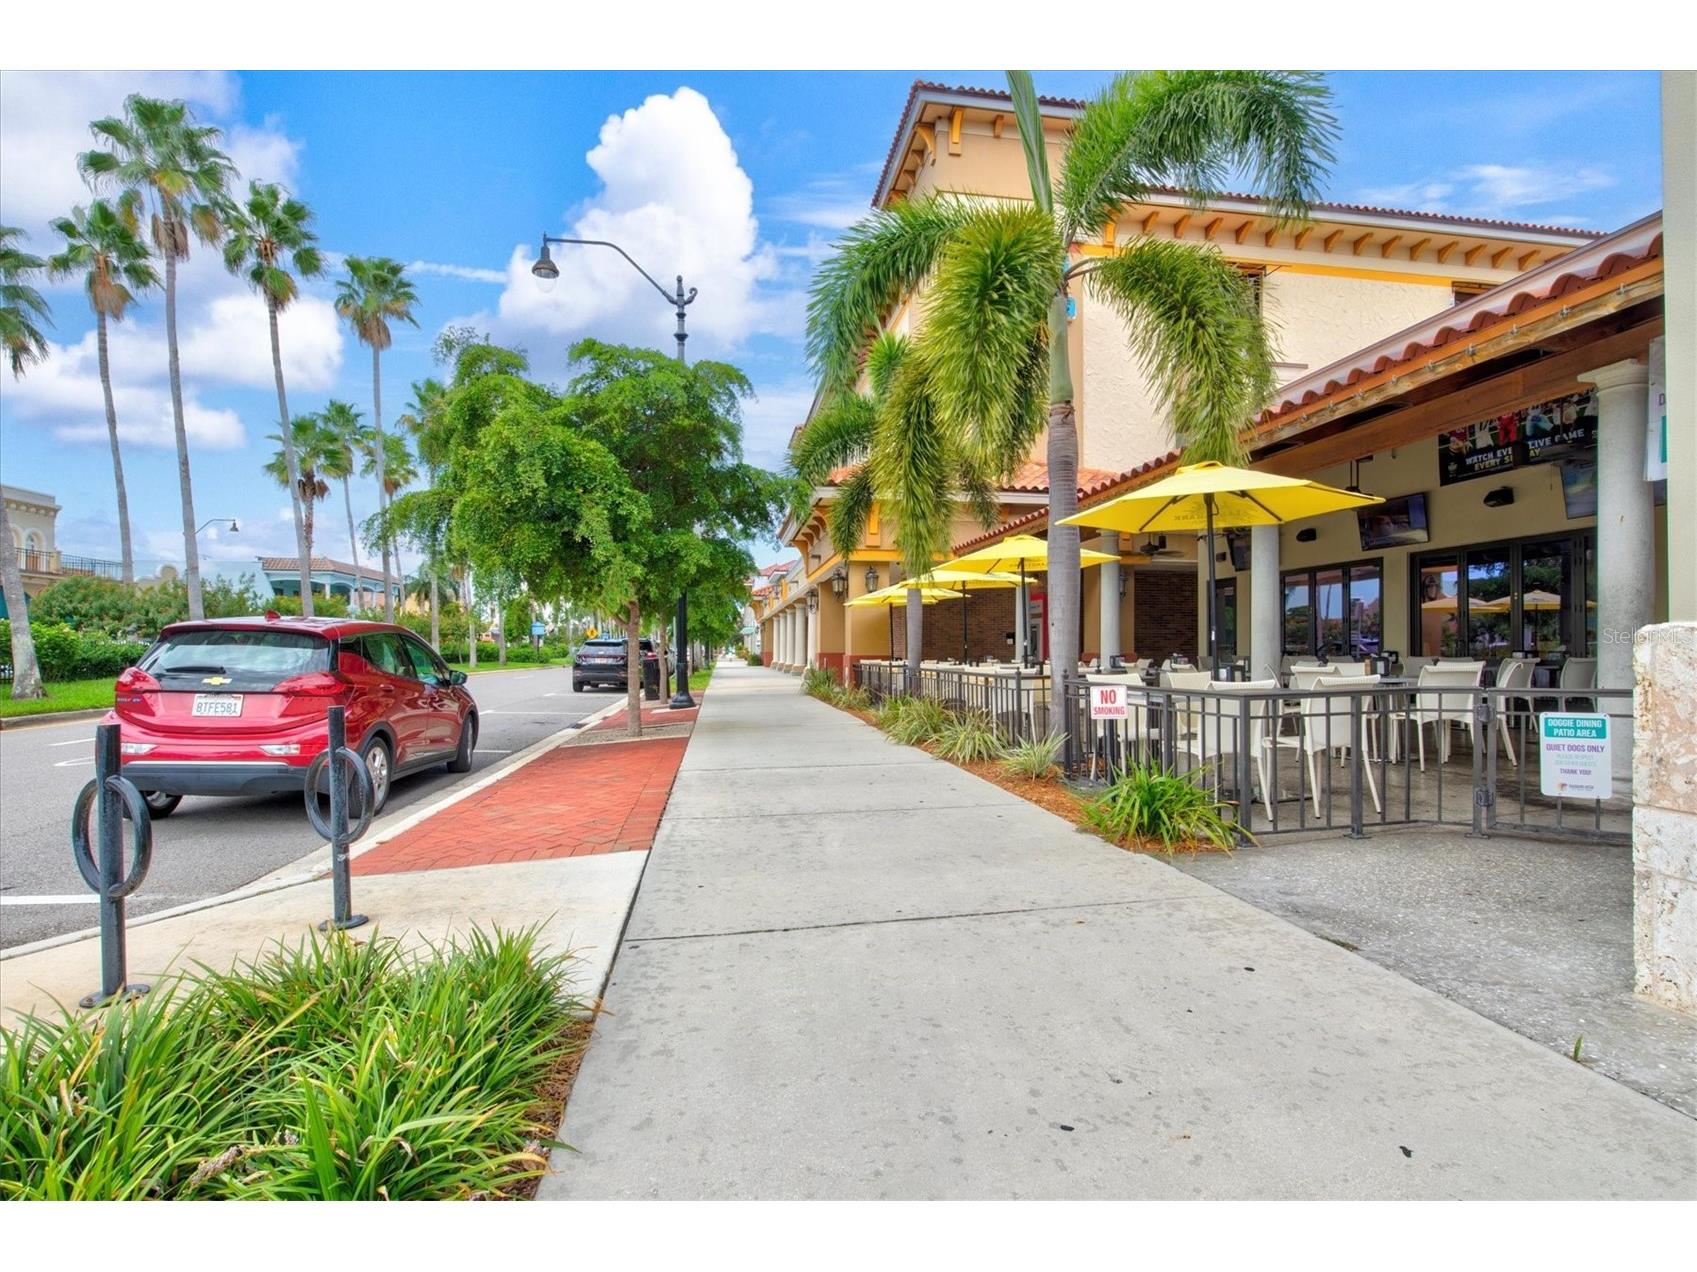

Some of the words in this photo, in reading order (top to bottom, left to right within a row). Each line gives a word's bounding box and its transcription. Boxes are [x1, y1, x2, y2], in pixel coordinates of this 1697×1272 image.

[1465, 451, 1494, 465] WATCH
[1527, 436, 1551, 449] LIVE
[1474, 458, 1501, 471] EVERY
[1100, 689, 1117, 705] NO
[1093, 706, 1125, 716] SMOKING
[1547, 718, 1575, 728] DOGGIE
[1576, 719, 1602, 728] DINING
[1553, 728, 1575, 737] PATIO
[1576, 729, 1597, 738] AREA
[1546, 743, 1566, 752] QUIET
[1567, 743, 1586, 753] DOGS
[1586, 744, 1605, 753] ONLY
